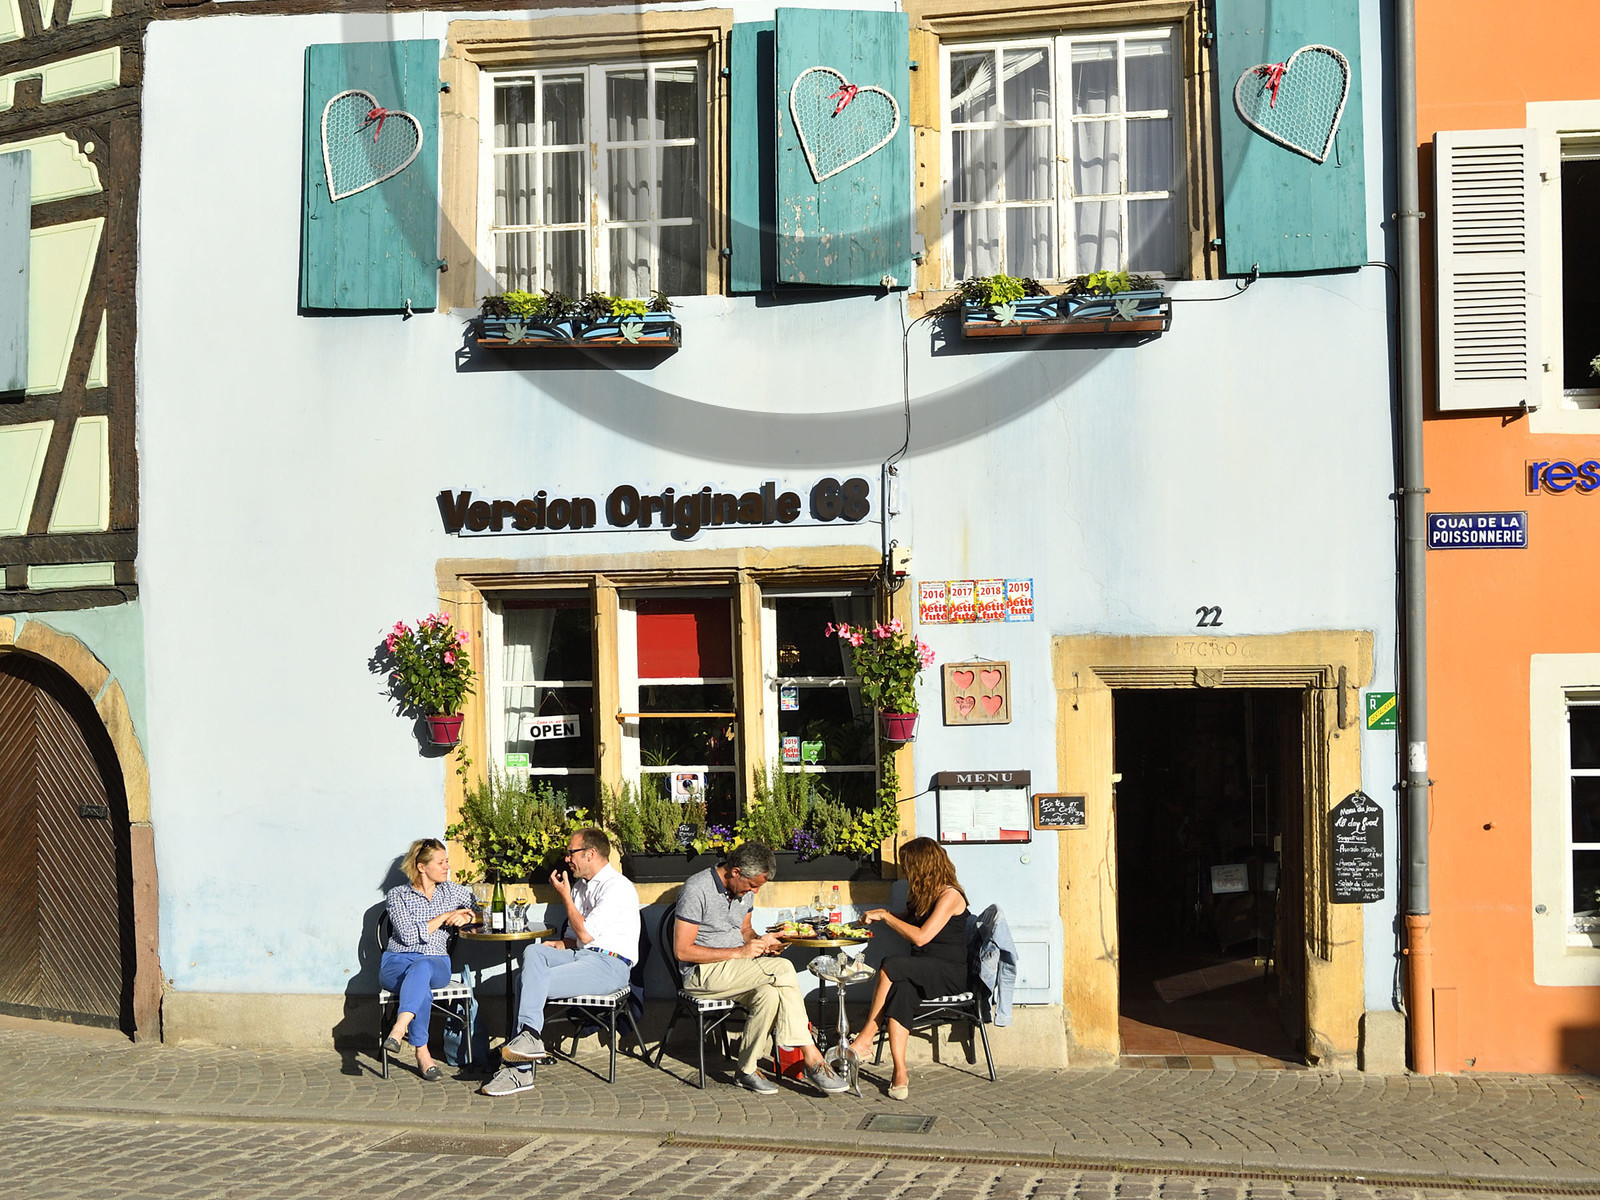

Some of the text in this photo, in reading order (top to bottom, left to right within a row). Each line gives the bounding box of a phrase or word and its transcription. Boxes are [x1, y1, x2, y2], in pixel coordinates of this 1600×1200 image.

[438, 477, 871, 540] Version Originale 68
[1436, 517, 1519, 529] QUAI DE LA
[1433, 530, 1523, 544] POISSONNERIE
[952, 588, 973, 596] 2017
[980, 586, 1001, 596] 2018
[1008, 582, 1030, 593] 2019
[923, 590, 945, 599] 2016
[1195, 605, 1224, 627] 22
[1370, 698, 1377, 710] R
[530, 723, 575, 738] OPEN
[956, 772, 1014, 783] MENU
